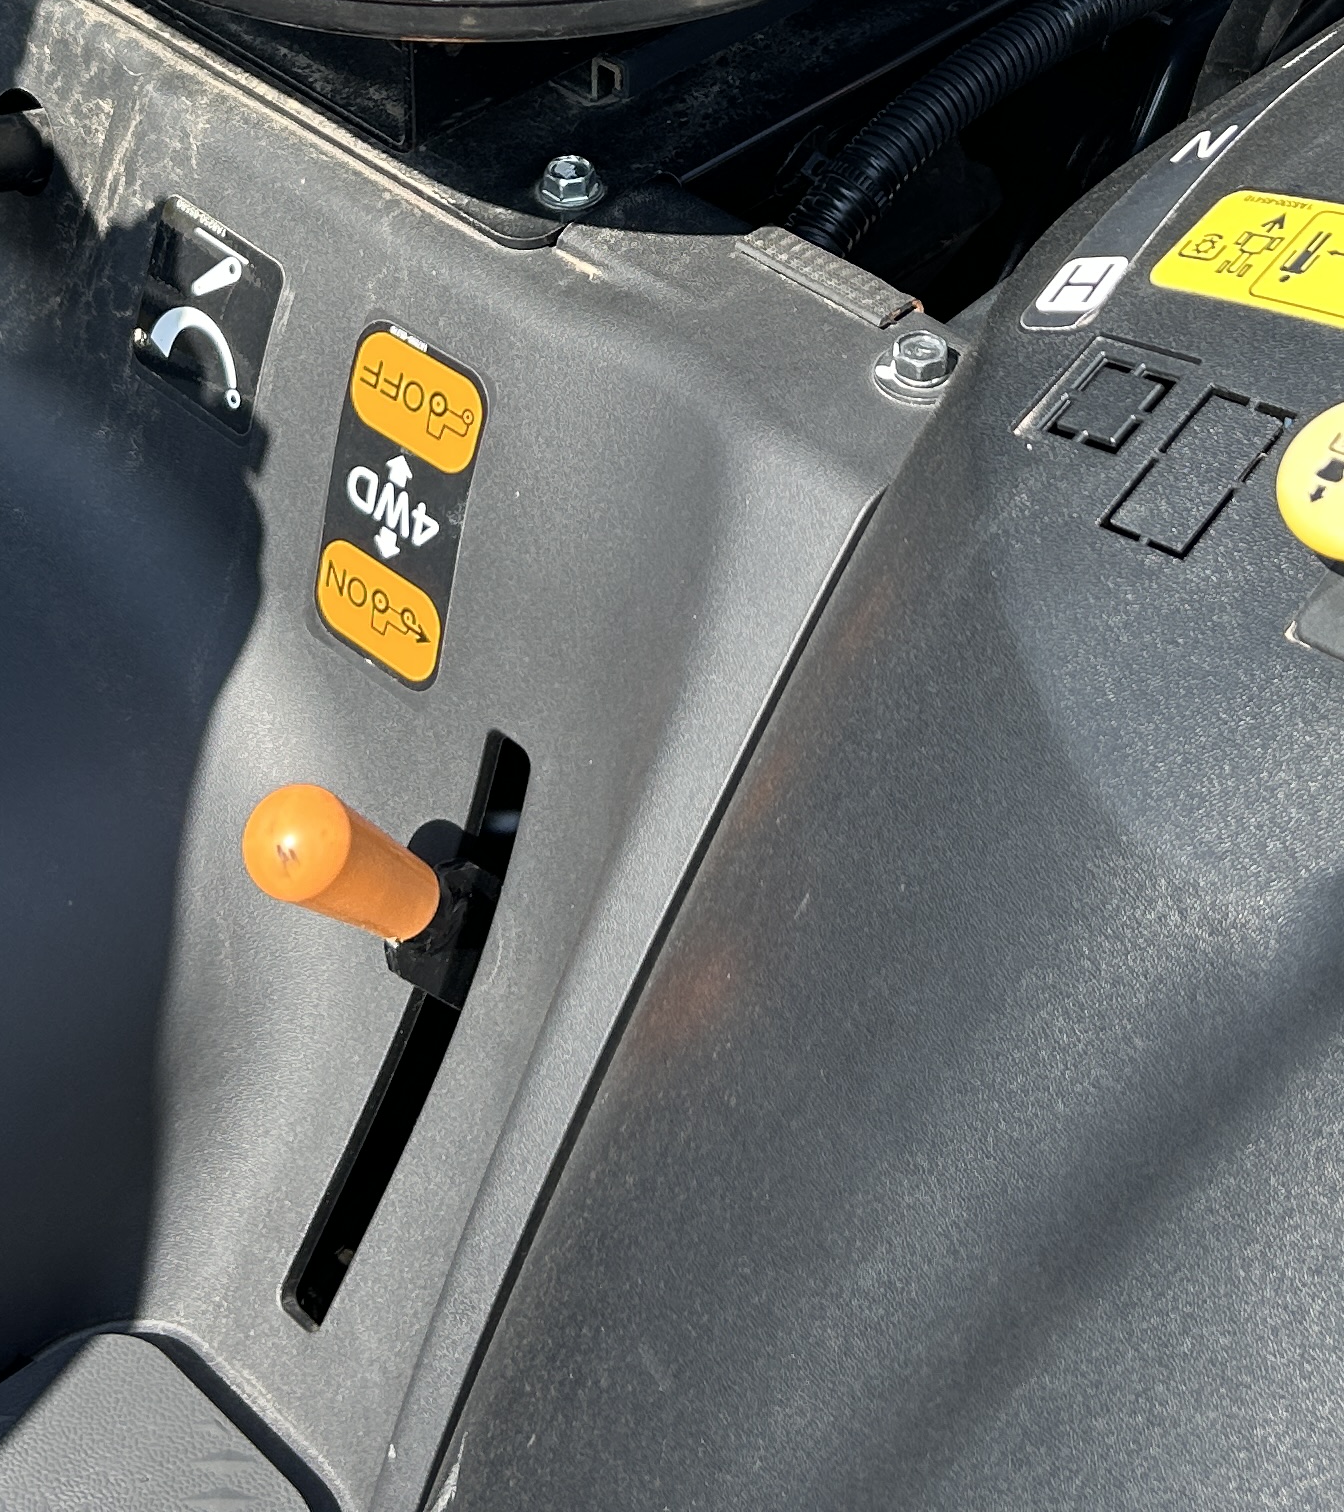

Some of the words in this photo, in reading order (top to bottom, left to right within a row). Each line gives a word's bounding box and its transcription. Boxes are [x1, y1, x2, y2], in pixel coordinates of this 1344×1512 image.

[1168, 124, 1240, 164] N
[1047, 263, 1116, 303] H
[359, 359, 425, 413] OFF
[345, 464, 440, 547] 4WD
[324, 559, 369, 608] ON
